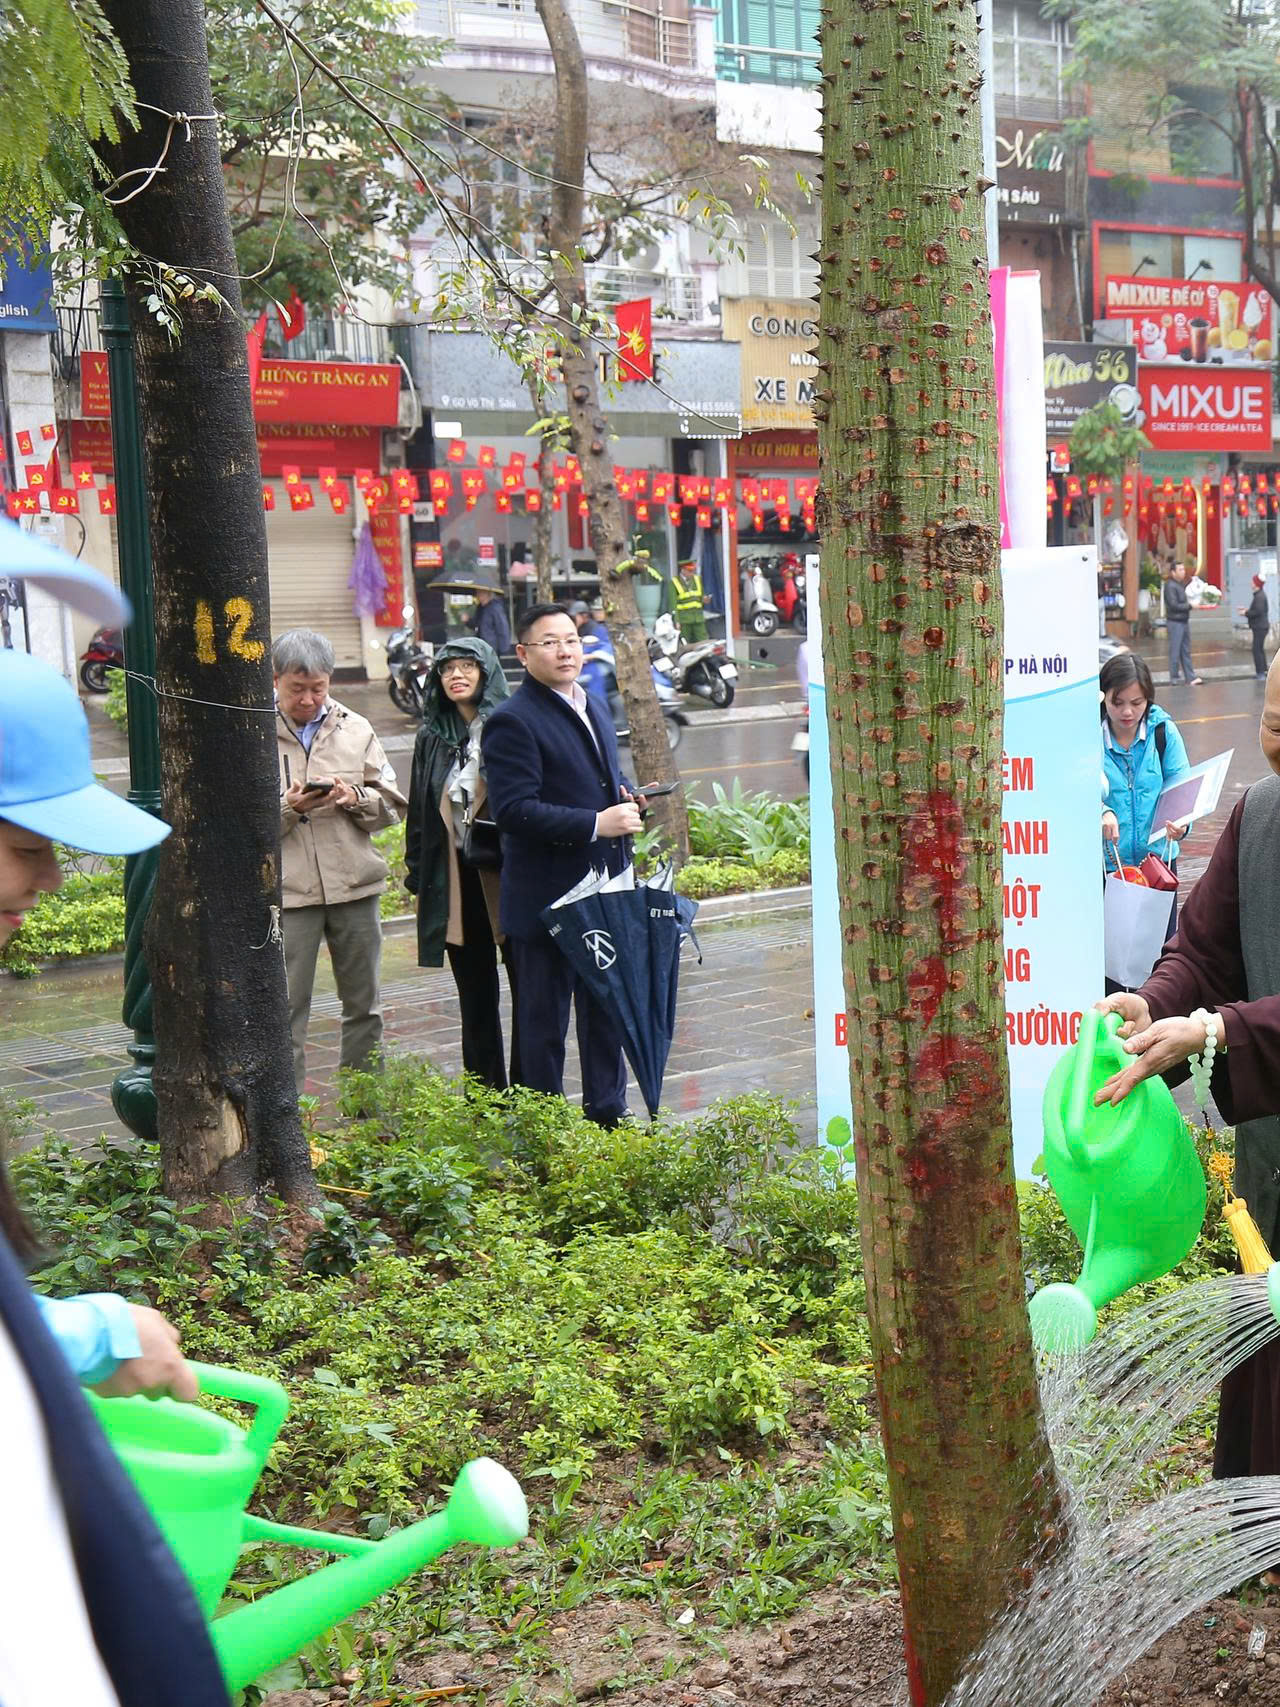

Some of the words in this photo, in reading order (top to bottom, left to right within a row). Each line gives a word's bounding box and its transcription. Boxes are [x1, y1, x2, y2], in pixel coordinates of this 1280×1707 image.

[1107, 281, 1170, 306] MIXUE
[1095, 348, 1129, 383] 56
[368, 374, 389, 387] AN
[756, 378, 786, 402] XE
[1151, 384, 1263, 419] MIXUE
[1152, 422, 1176, 432] SINCE
[194, 595, 265, 664] 12
[1019, 654, 1038, 675] HÀ
[1042, 653, 1067, 677] NỘI
